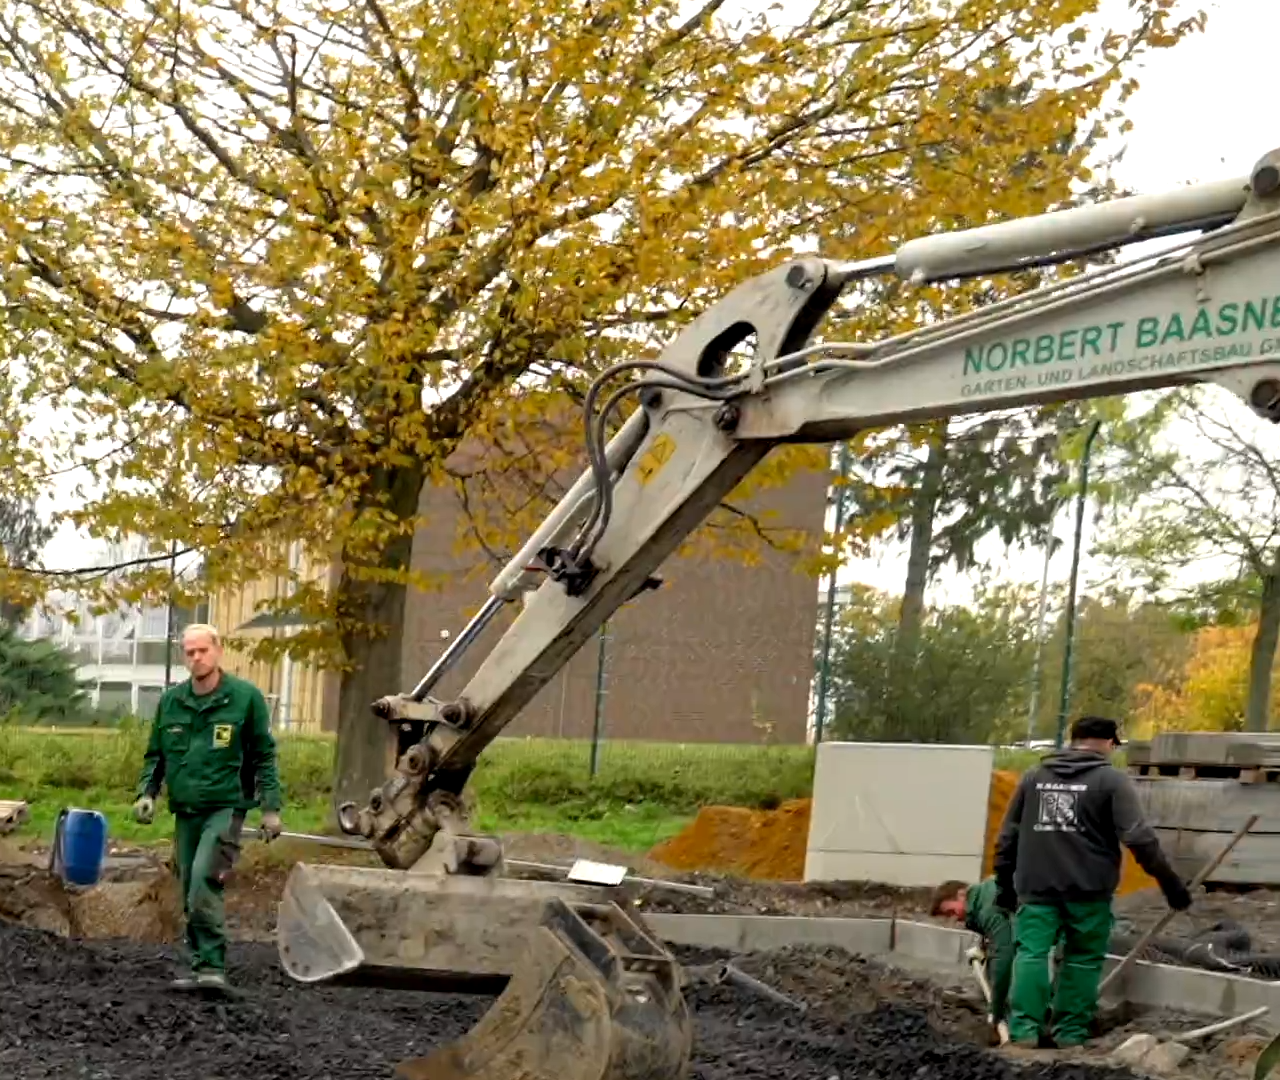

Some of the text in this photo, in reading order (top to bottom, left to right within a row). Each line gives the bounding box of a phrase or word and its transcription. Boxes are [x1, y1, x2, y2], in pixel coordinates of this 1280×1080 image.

[963, 321, 1125, 375] NORBERT
[1037, 368, 1072, 387] UND
[1078, 342, 1252, 381] LANDSCHAFTSBAU
